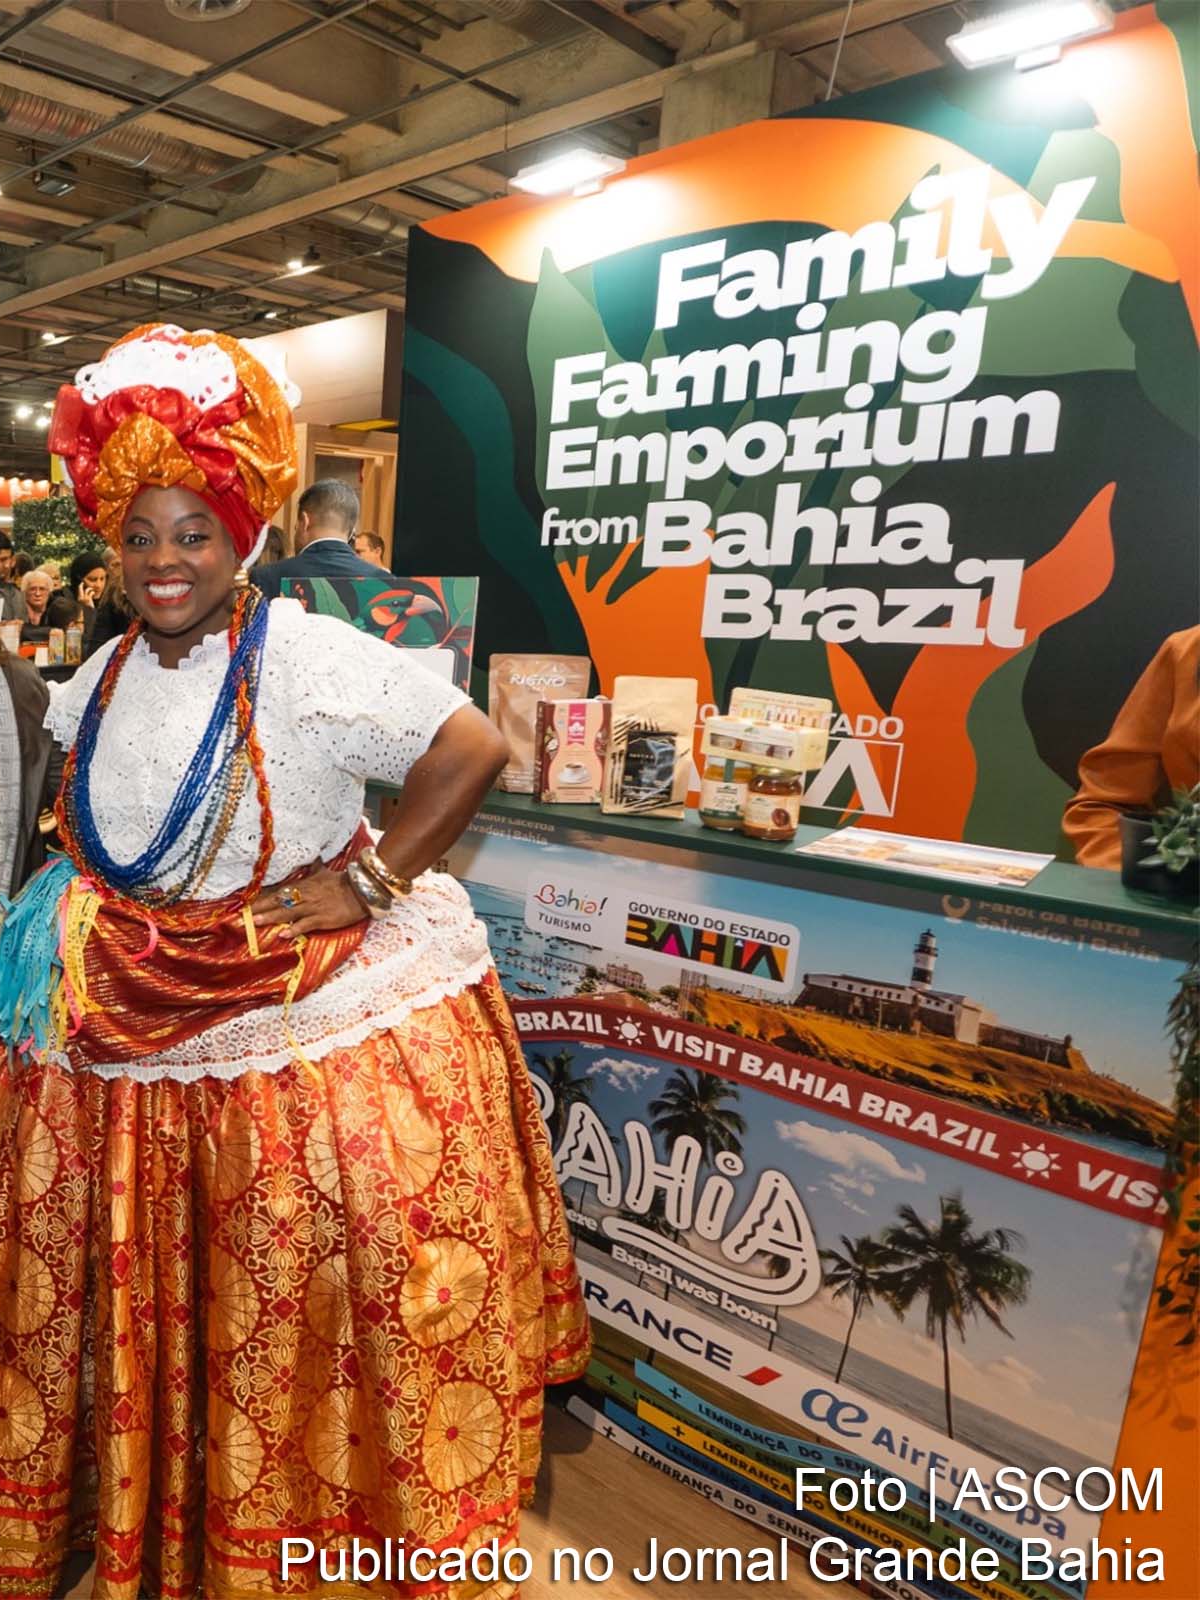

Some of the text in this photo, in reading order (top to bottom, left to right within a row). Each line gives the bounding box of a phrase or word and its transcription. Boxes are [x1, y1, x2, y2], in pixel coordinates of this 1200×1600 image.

[654, 160, 1096, 330] Family
[549, 301, 988, 425] Farming
[545, 382, 1061, 499] Emporium
[540, 476, 953, 568] from Bahia
[701, 557, 1026, 648] Brazil
[534, 884, 608, 916] Bahia!
[538, 911, 592, 933] TURISMO
[628, 901, 791, 947] GOVERNO DO ESTADO
[625, 913, 789, 982] BAHIA
[515, 1010, 609, 1036] BRAZIL
[652, 1026, 736, 1067] VISIT
[742, 1055, 852, 1110] BAHIA
[858, 1092, 1002, 1160] BRAZIL
[611, 1245, 777, 1333] Brazil was born
[698, 1403, 788, 1452] LEMBRANÇA
[798, 1445, 823, 1460] DO
[702, 1441, 793, 1495] LEMBRANÇA
[633, 1444, 724, 1500] LEMBRANÇA
[733, 1498, 757, 1516] DO
